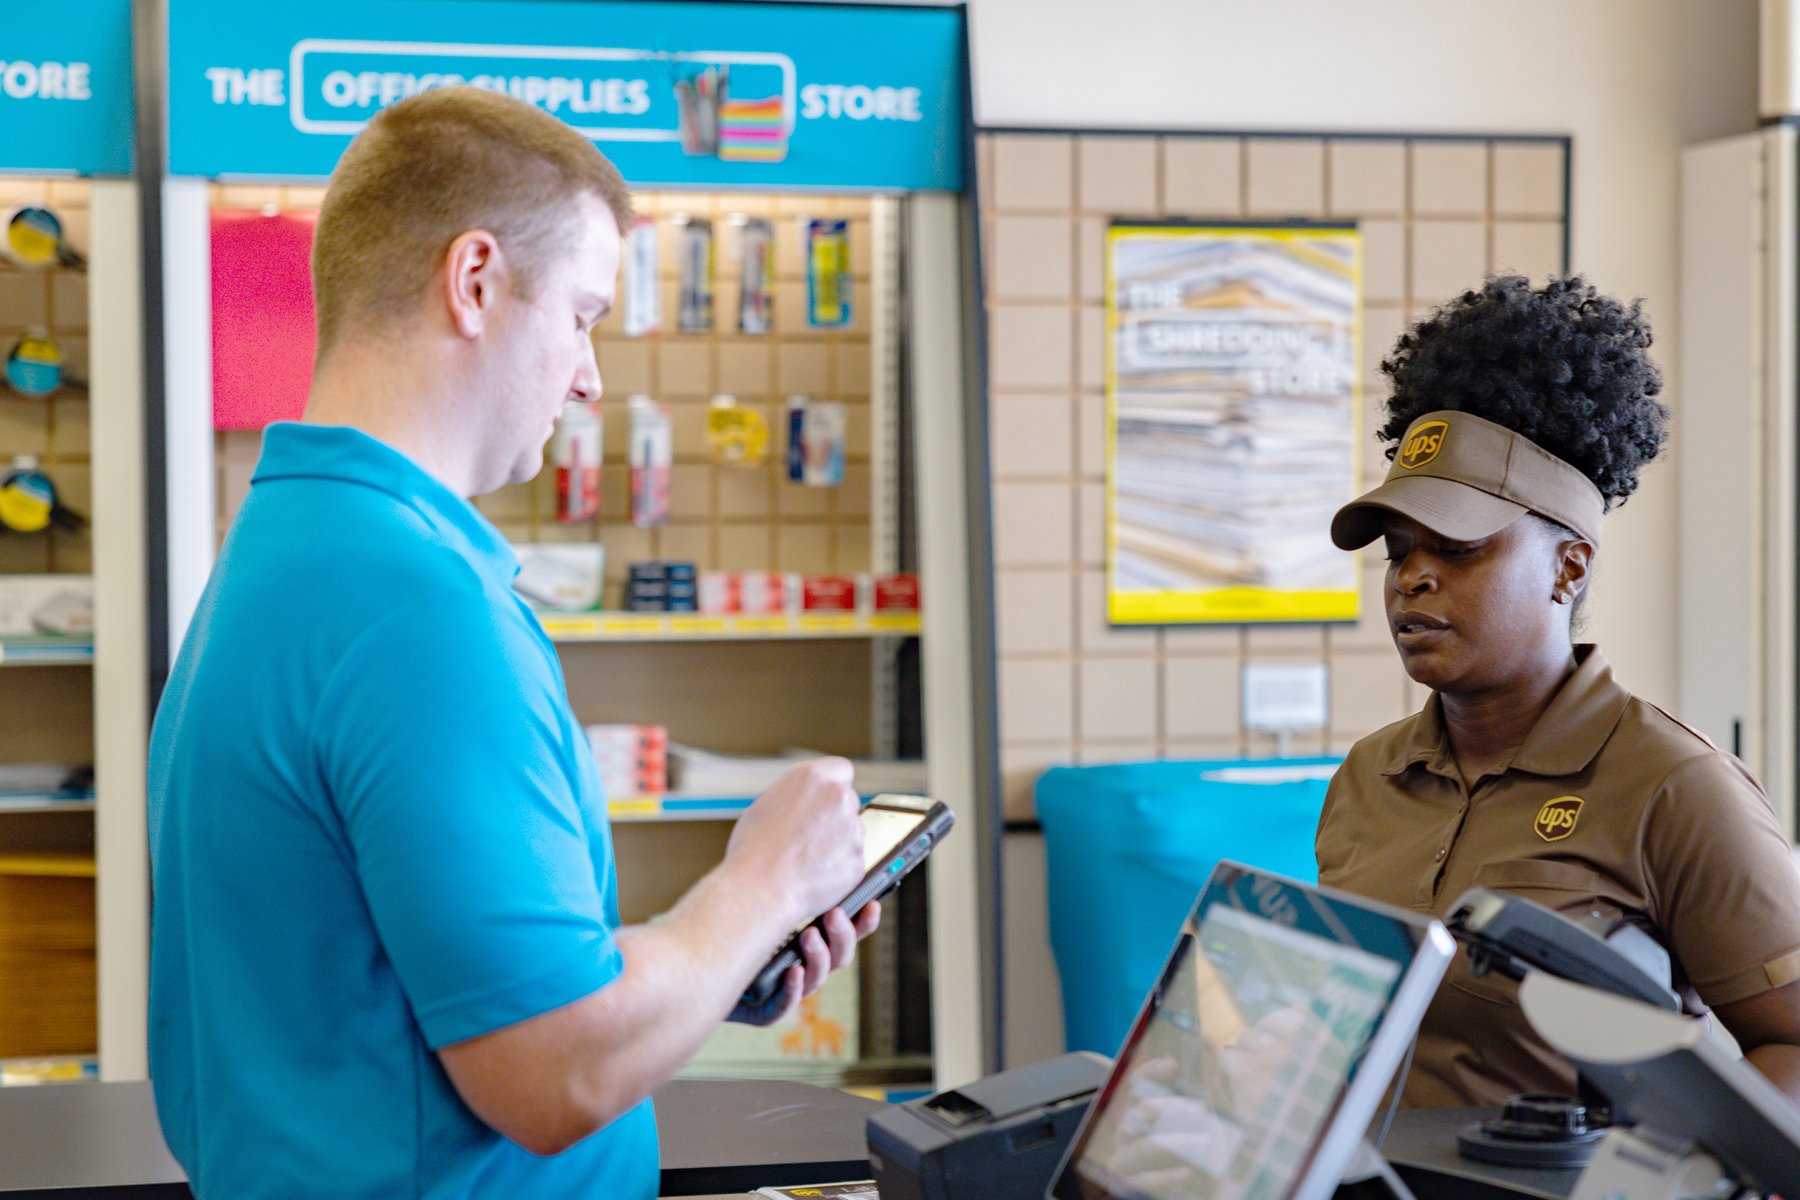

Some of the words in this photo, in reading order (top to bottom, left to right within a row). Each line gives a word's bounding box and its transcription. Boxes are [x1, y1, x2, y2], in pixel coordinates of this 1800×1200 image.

[0, 60, 92, 100] ORE
[205, 67, 286, 106] THE
[801, 83, 923, 121] STORE
[1403, 434, 1440, 461] ups
[1539, 807, 1576, 832] ups
